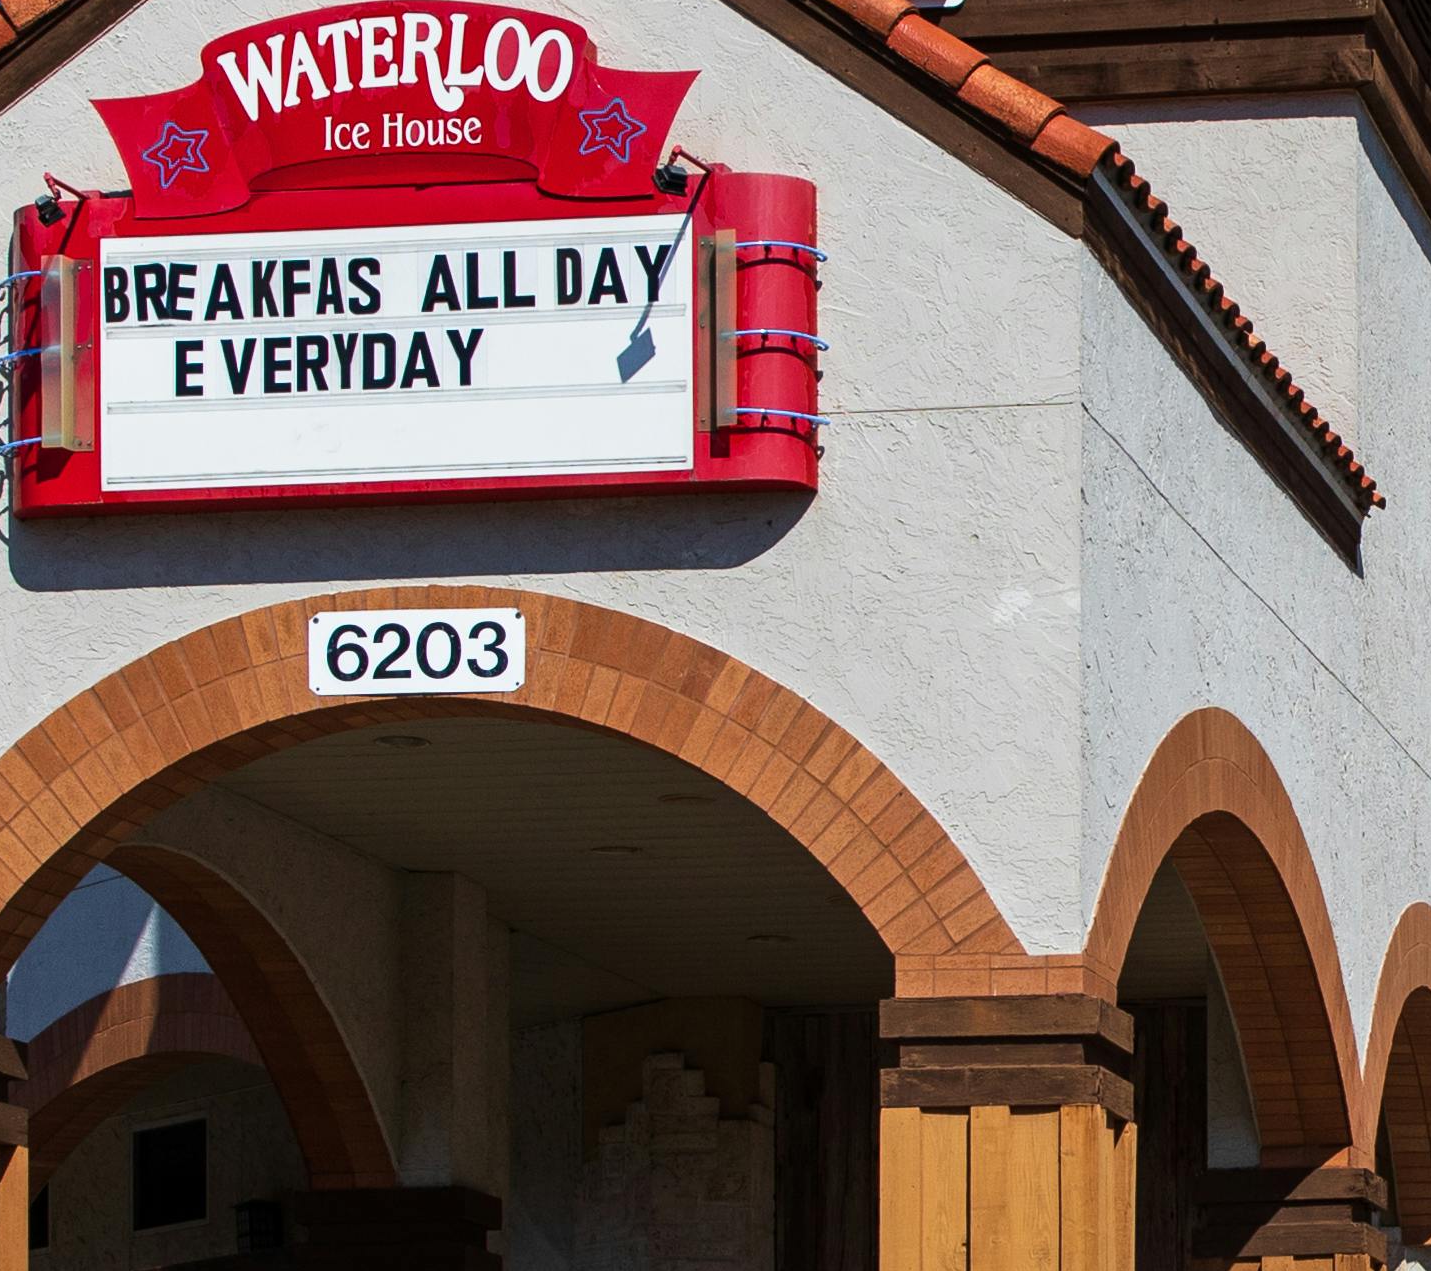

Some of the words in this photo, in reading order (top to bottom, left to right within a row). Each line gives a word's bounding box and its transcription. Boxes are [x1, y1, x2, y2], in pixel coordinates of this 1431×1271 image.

[216, 13, 574, 123] WATERLOO
[324, 113, 370, 150] Ice
[381, 111, 482, 149] House
[103, 255, 382, 324] BREAKFAS
[422, 249, 536, 312] ALL
[557, 243, 671, 307] DAY
[326, 621, 509, 682] 6203
